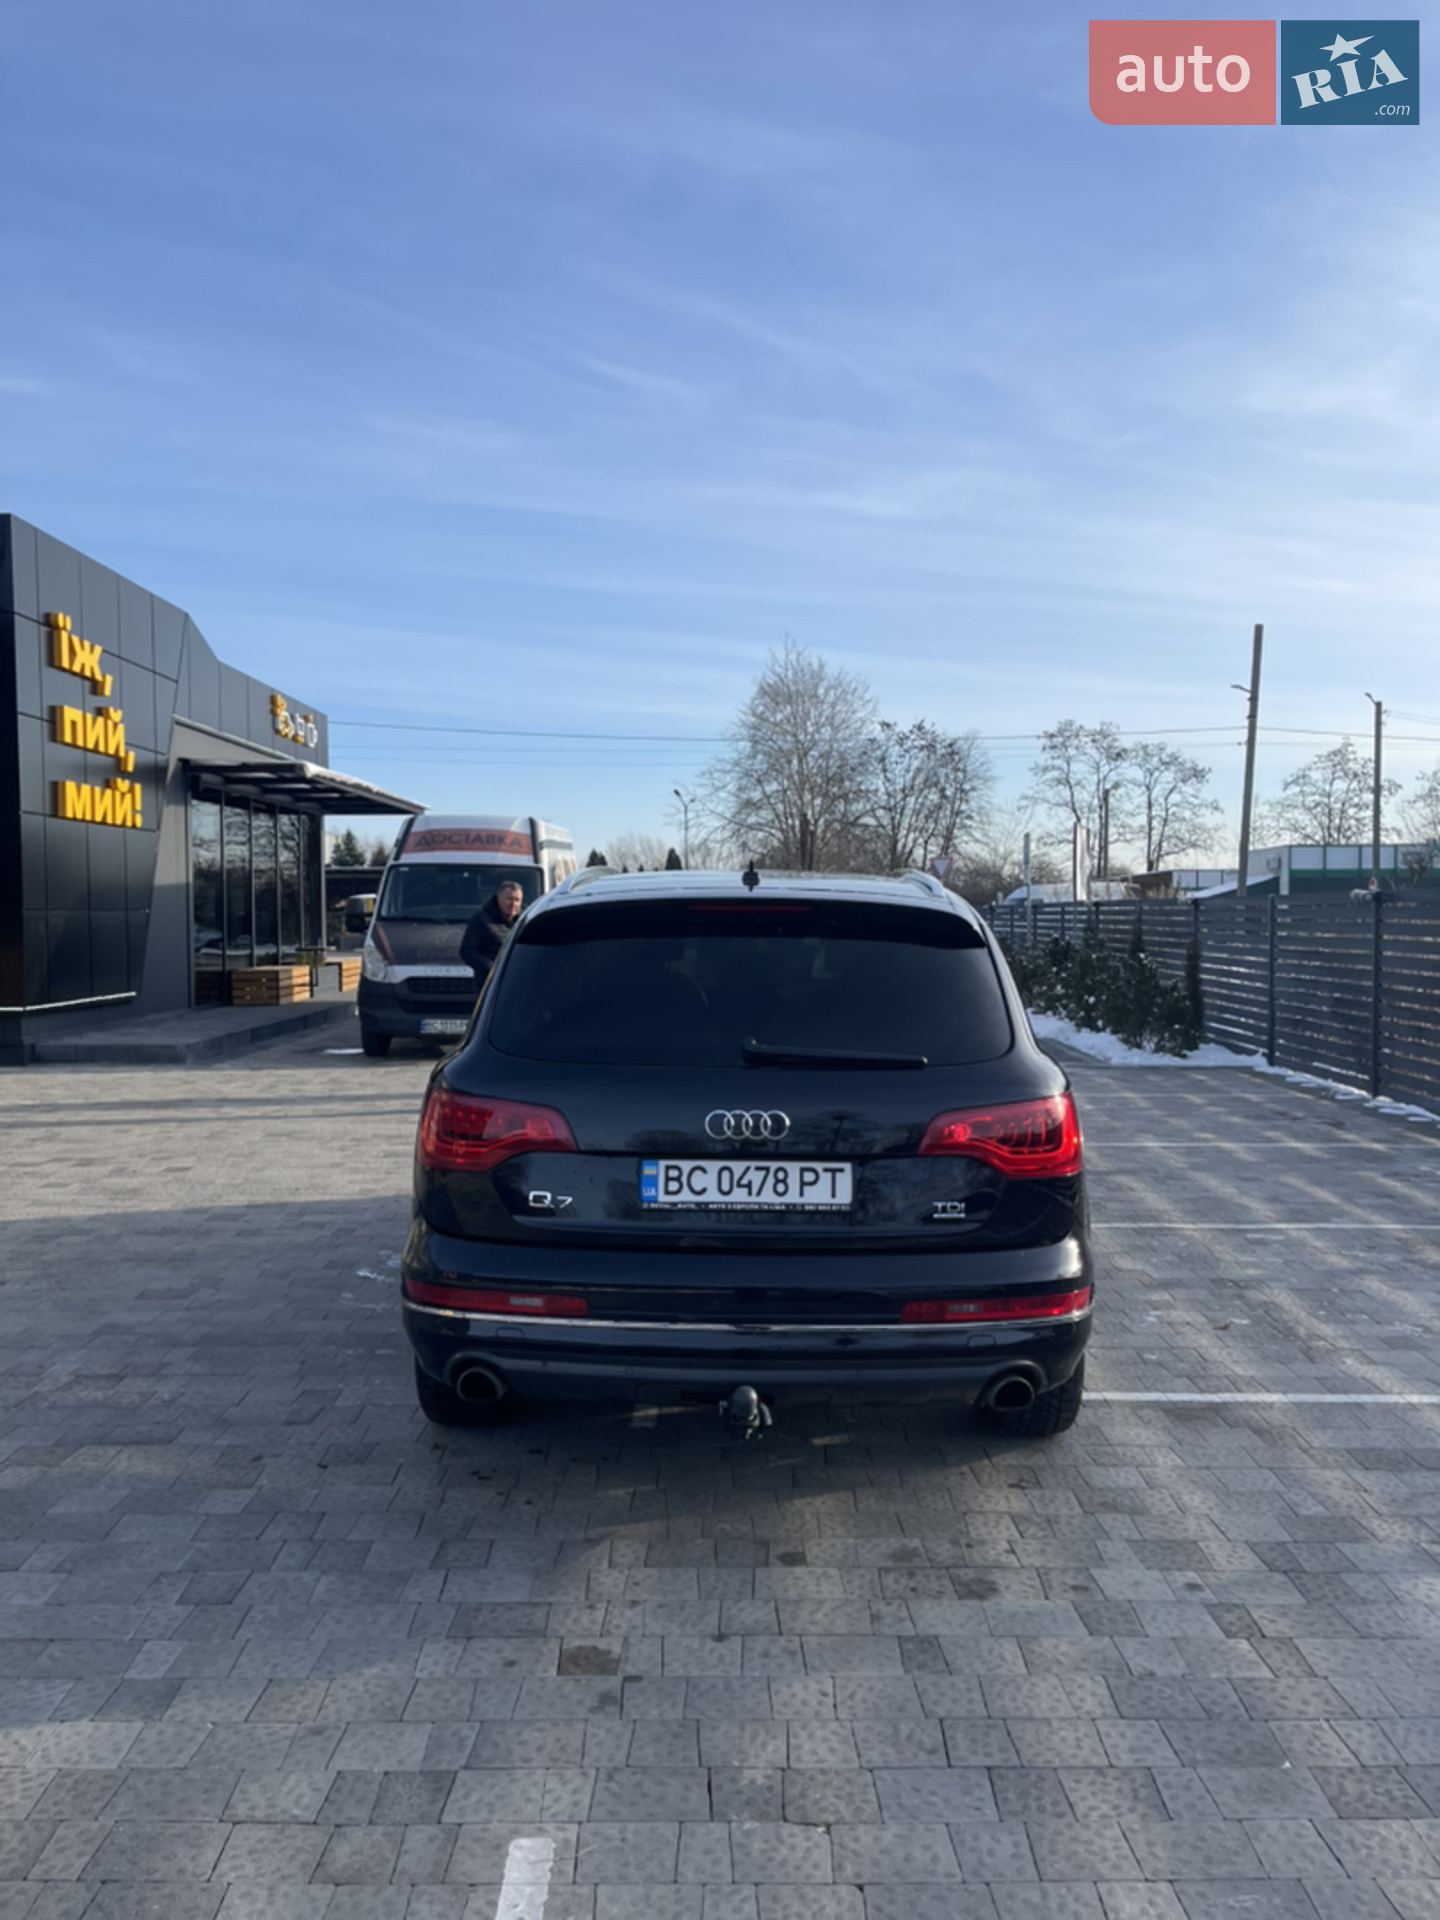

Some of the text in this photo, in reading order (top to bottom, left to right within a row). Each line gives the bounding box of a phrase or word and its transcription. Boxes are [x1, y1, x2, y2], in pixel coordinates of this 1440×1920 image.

[414, 832, 523, 849] ДОСТАВКА
[664, 1164, 845, 1199] BC 0478 PT
[643, 1186, 656, 1196] UA
[932, 1201, 966, 1213] TDI
